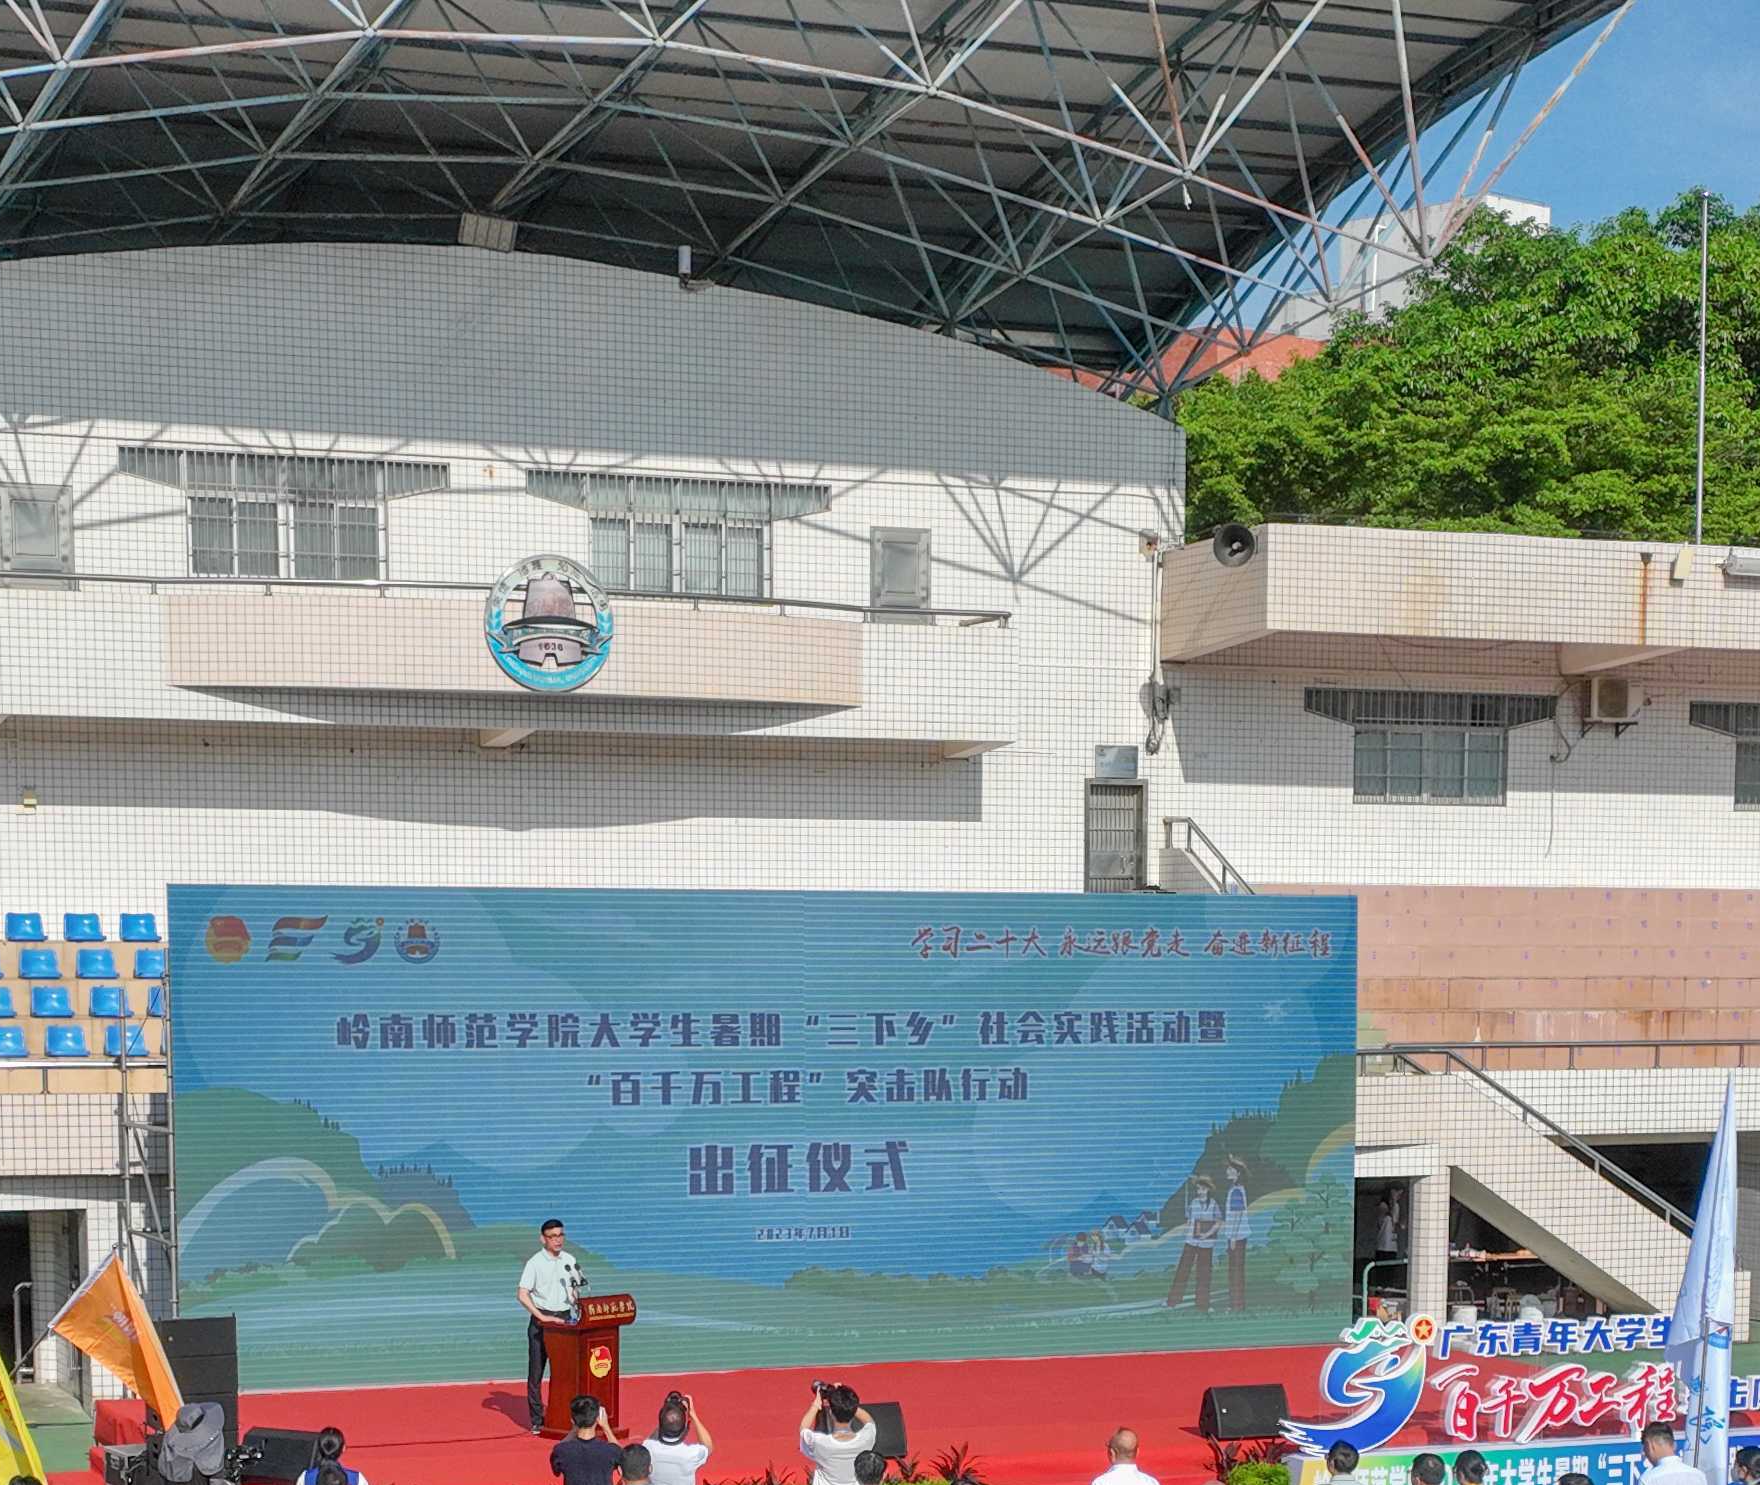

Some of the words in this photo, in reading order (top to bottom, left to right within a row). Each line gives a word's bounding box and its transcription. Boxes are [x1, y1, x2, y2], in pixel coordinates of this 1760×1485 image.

[910, 925, 1047, 959] 学习二十大
[1059, 926, 1190, 959] 永远跟党走
[1203, 928, 1333, 959] 奋进新征程
[688, 1141, 909, 1195] 出征仪式
[756, 1226, 851, 1241] 2023年7月1日
[1440, 1316, 1674, 1359] 广东青年大学生
[1436, 1363, 1677, 1442] 百千万工程
